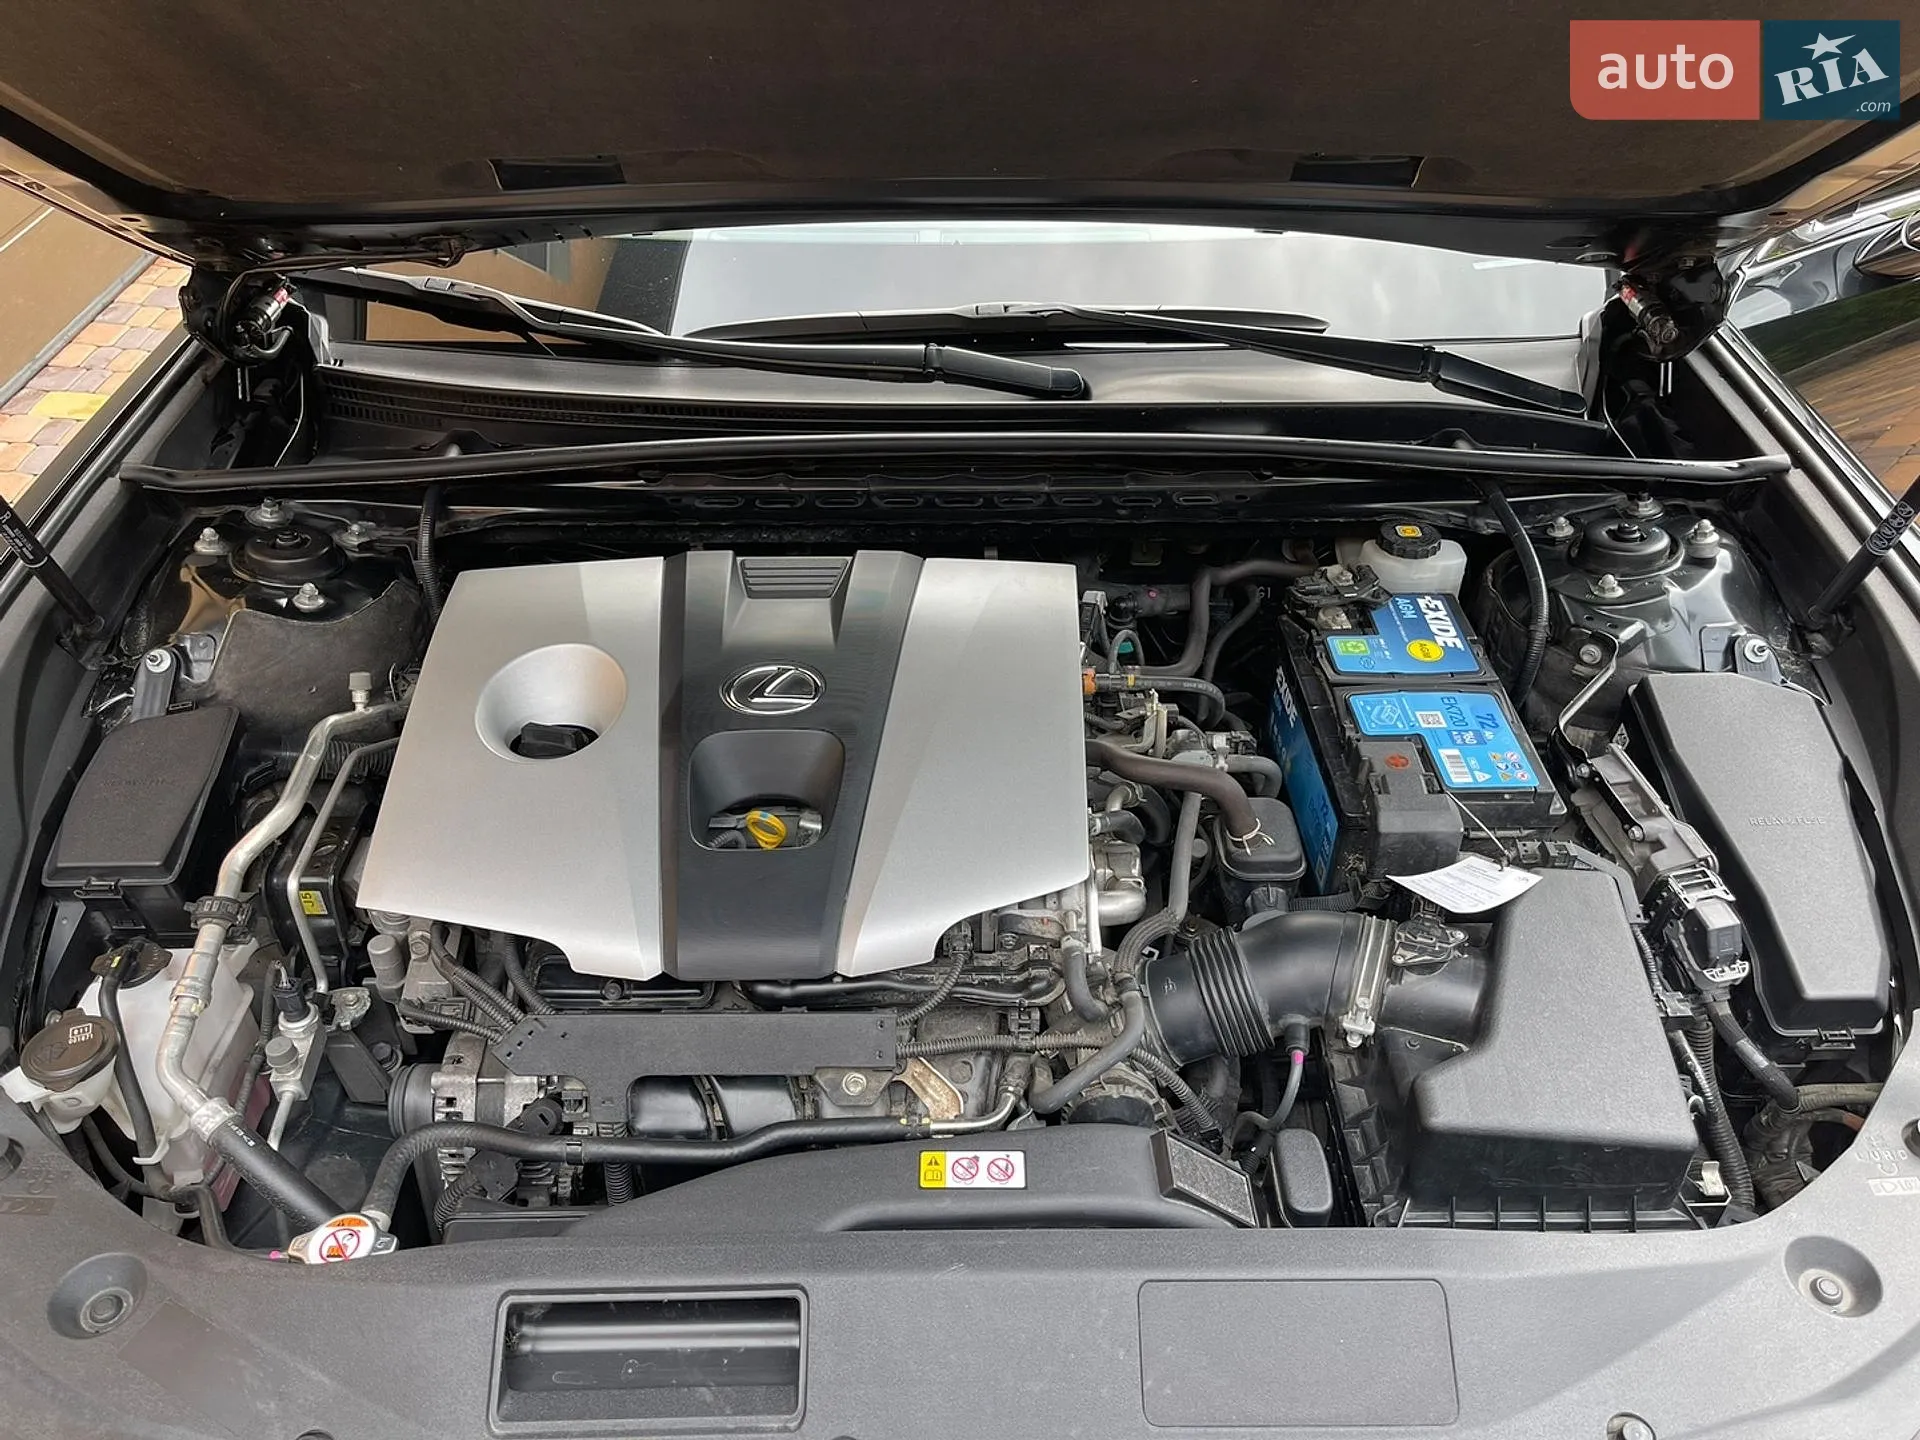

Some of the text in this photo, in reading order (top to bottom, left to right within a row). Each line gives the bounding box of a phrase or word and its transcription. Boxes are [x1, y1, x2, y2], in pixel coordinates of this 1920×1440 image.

[1395, 597, 1418, 619] AGM
[1416, 595, 1465, 651] EXIDE
[1441, 696, 1469, 727] EK720
[1475, 713, 1500, 729] 72
[302, 892, 315, 907] J5
